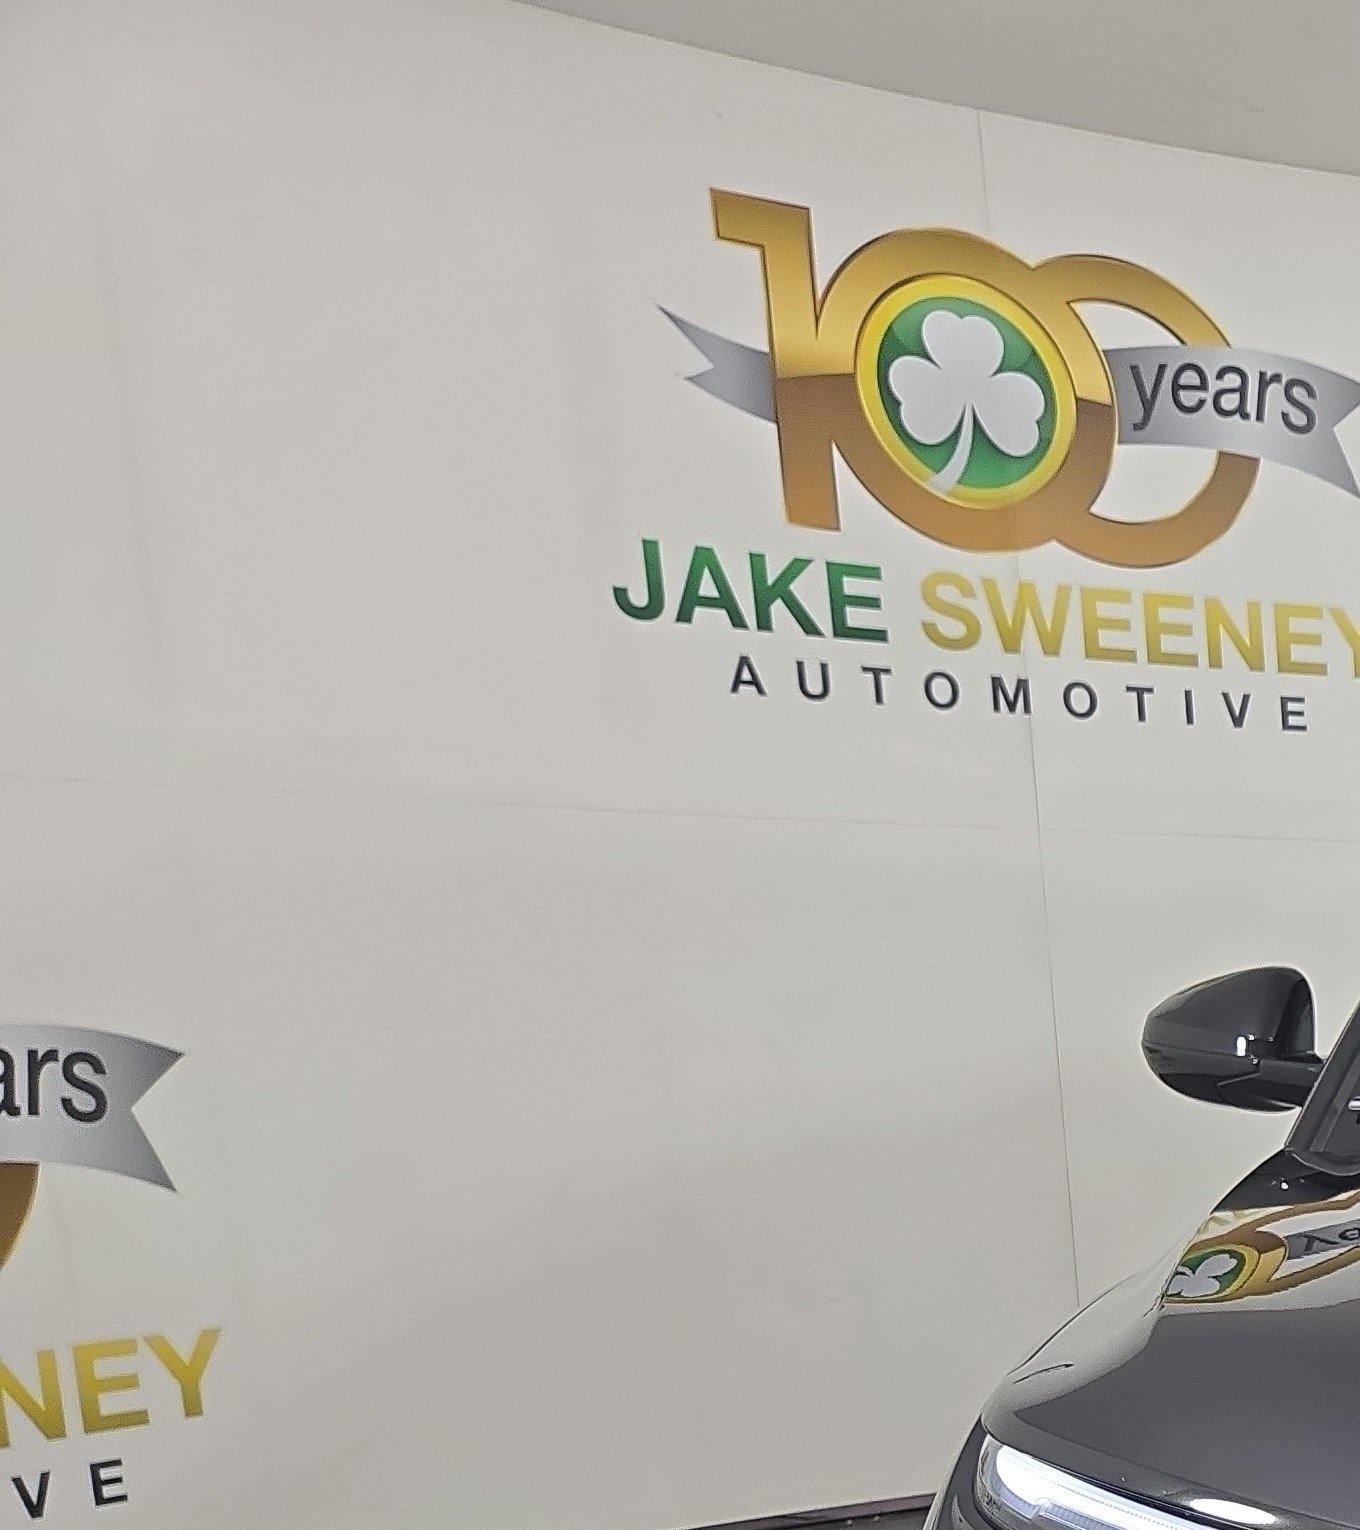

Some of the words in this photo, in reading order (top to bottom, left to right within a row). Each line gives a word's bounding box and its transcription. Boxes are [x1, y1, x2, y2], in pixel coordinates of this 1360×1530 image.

[1128, 362, 1319, 434] years
[612, 538, 890, 643] JAKE
[730, 654, 1308, 732] AUTOMOTIVE
